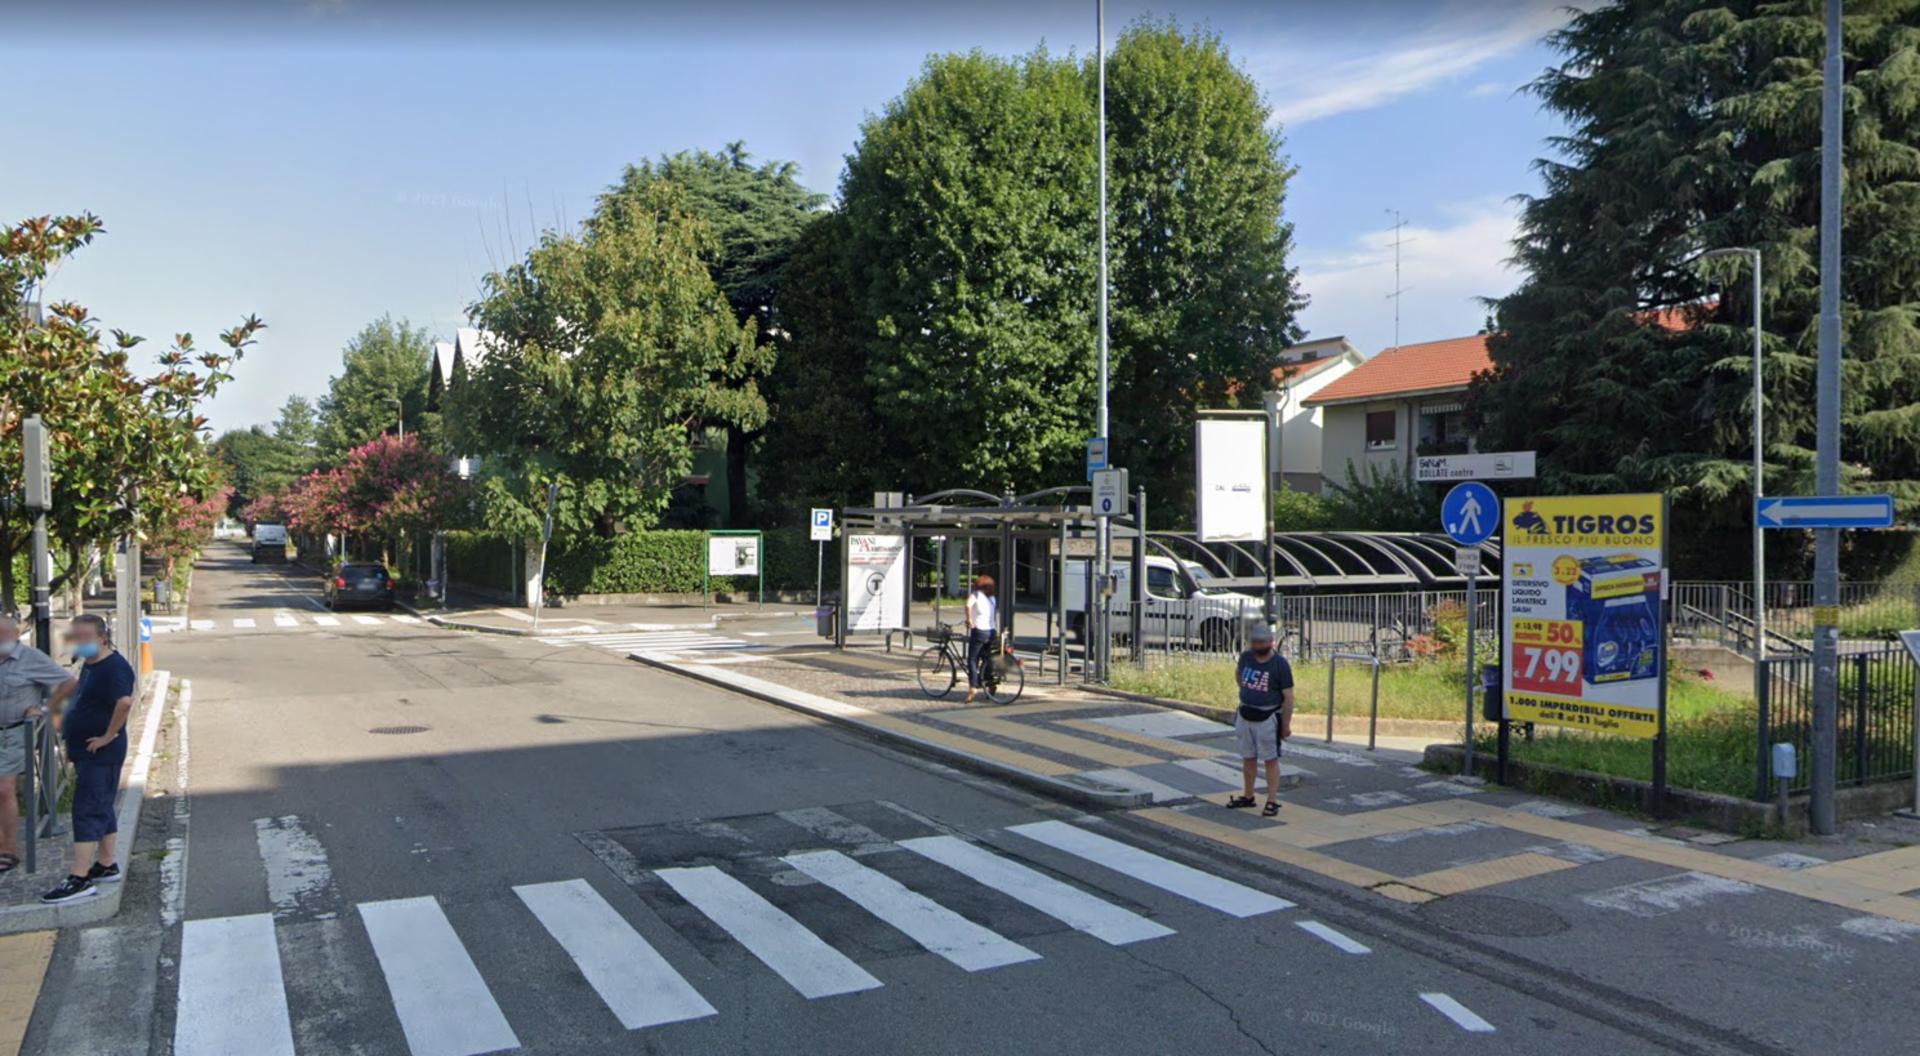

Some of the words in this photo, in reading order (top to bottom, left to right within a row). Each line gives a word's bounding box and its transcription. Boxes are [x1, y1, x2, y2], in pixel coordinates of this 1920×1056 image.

[817, 512, 828, 524] P
[1553, 514, 1655, 535] TIGROS
[1526, 536, 1572, 545] FRESCO
[1605, 536, 1655, 545] BUONO
[1240, 666, 1270, 693] USA
[1540, 700, 1605, 716] IMPERDIBILI
[1608, 709, 1655, 723] OFFERTE
[1578, 714, 1590, 724] 21
